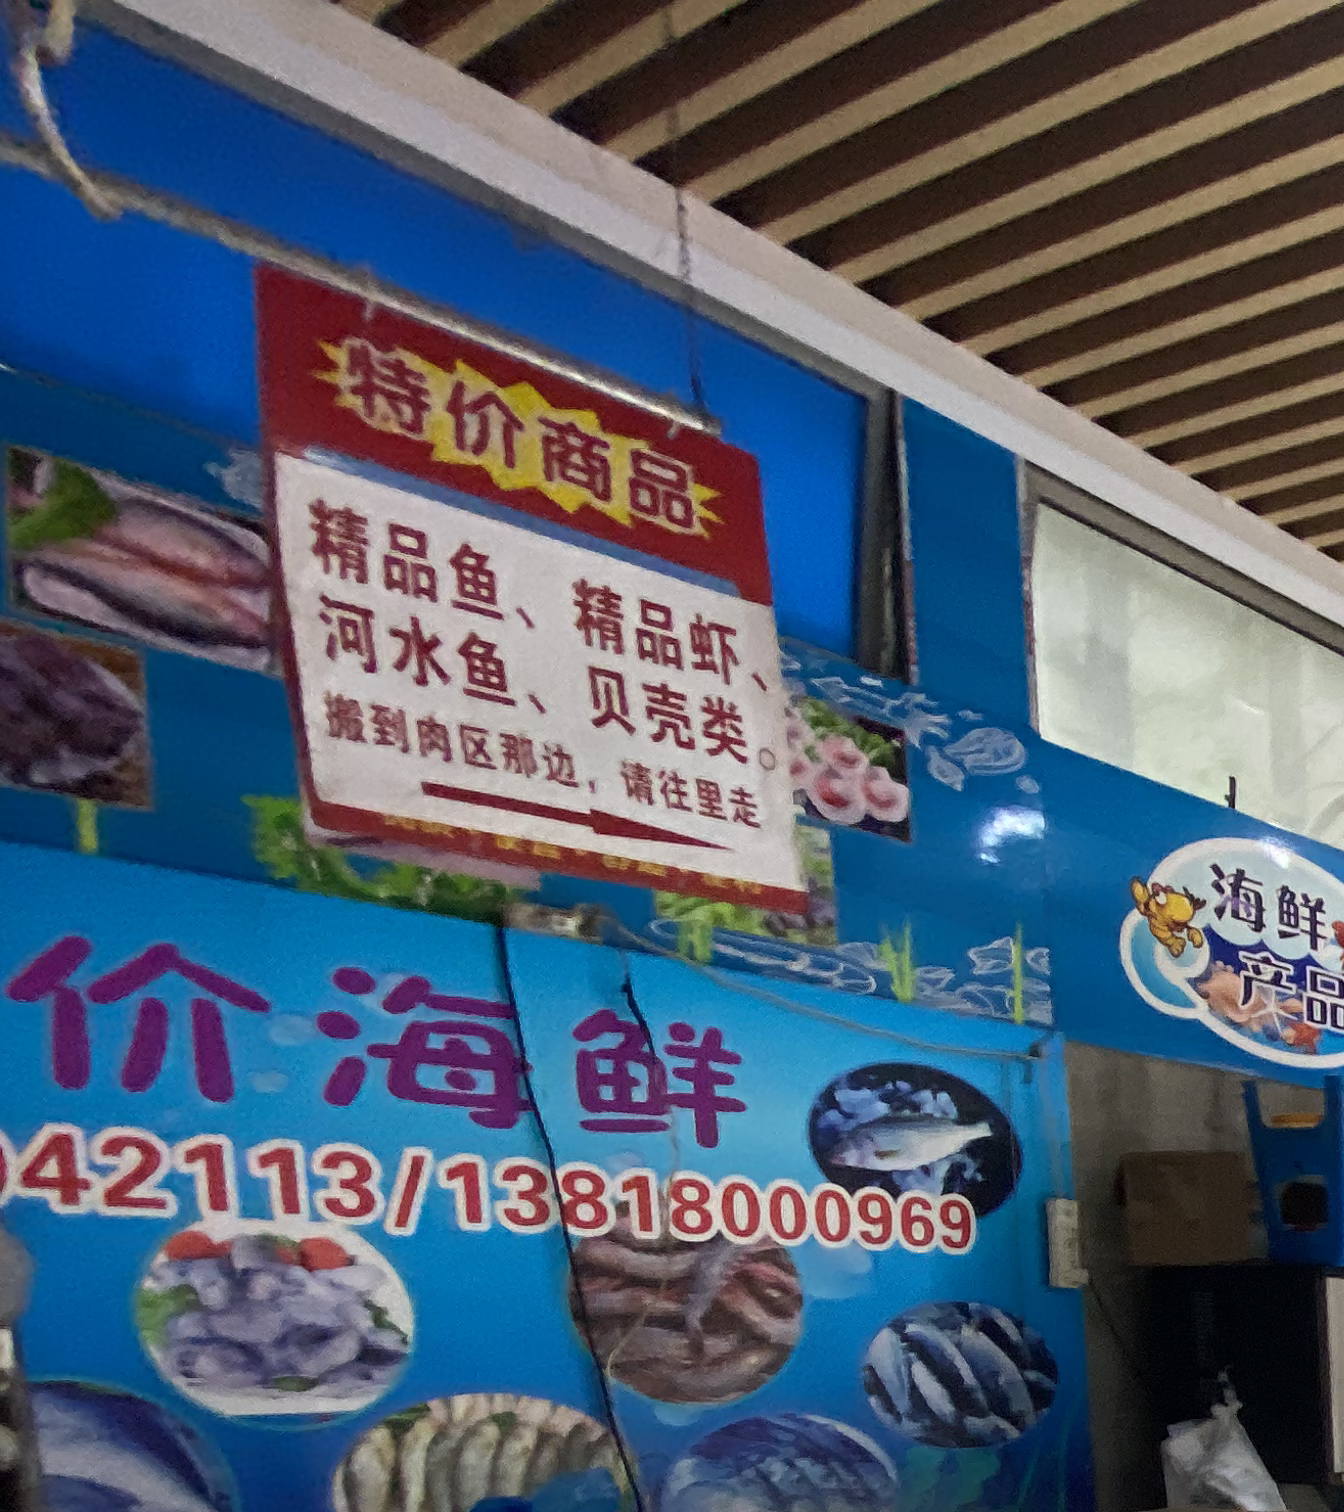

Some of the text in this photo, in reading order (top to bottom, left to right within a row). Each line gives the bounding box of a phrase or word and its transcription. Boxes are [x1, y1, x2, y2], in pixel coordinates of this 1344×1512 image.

[342, 336, 702, 534] 特价商品
[1207, 861, 1331, 952] 海鲜
[7, 934, 748, 1150] 价海鲜
[0, 1122, 976, 1254] 42113/13818000969
